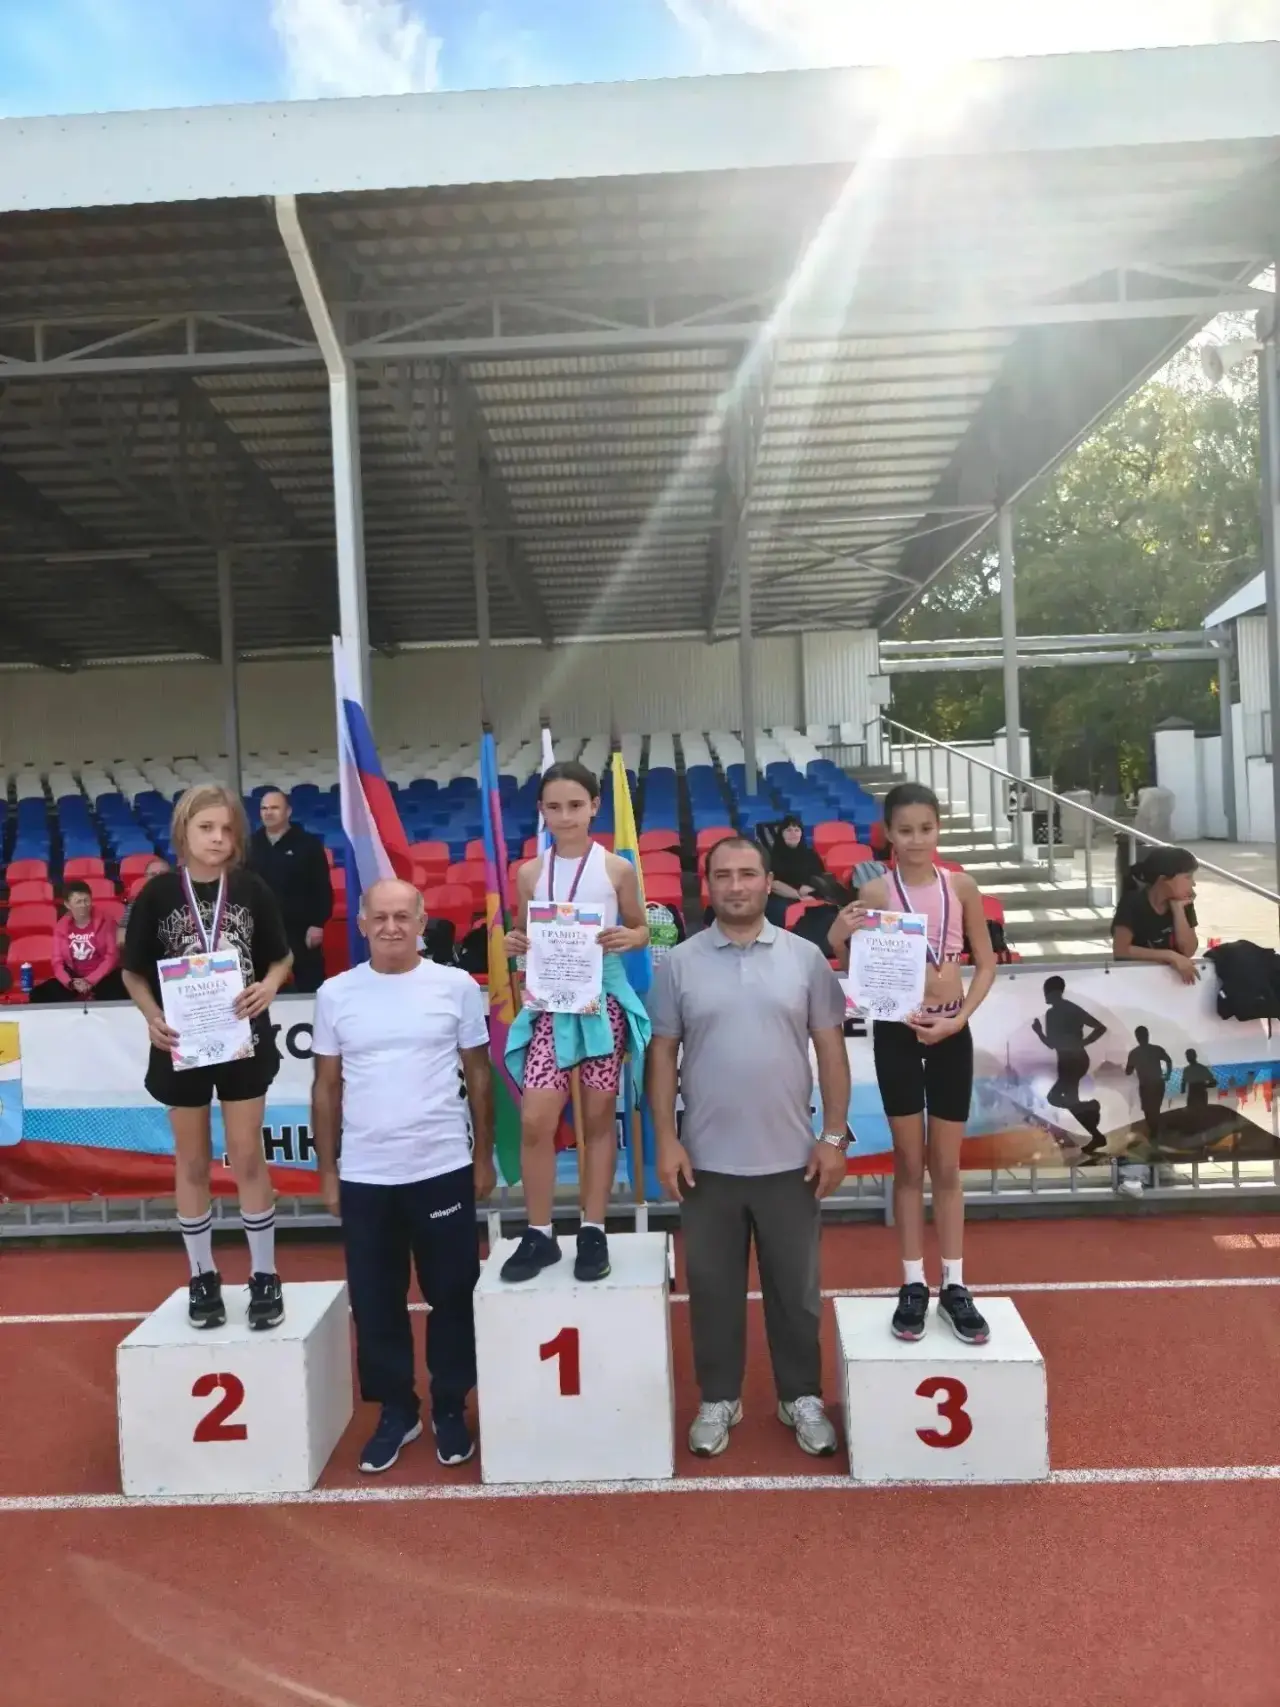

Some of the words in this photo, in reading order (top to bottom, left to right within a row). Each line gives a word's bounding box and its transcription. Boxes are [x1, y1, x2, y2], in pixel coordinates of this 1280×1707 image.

[430, 1202, 462, 1219] uhlsport
[539, 1327, 581, 1396] 1
[191, 1372, 248, 1442] 2
[915, 1376, 973, 1448] 3
